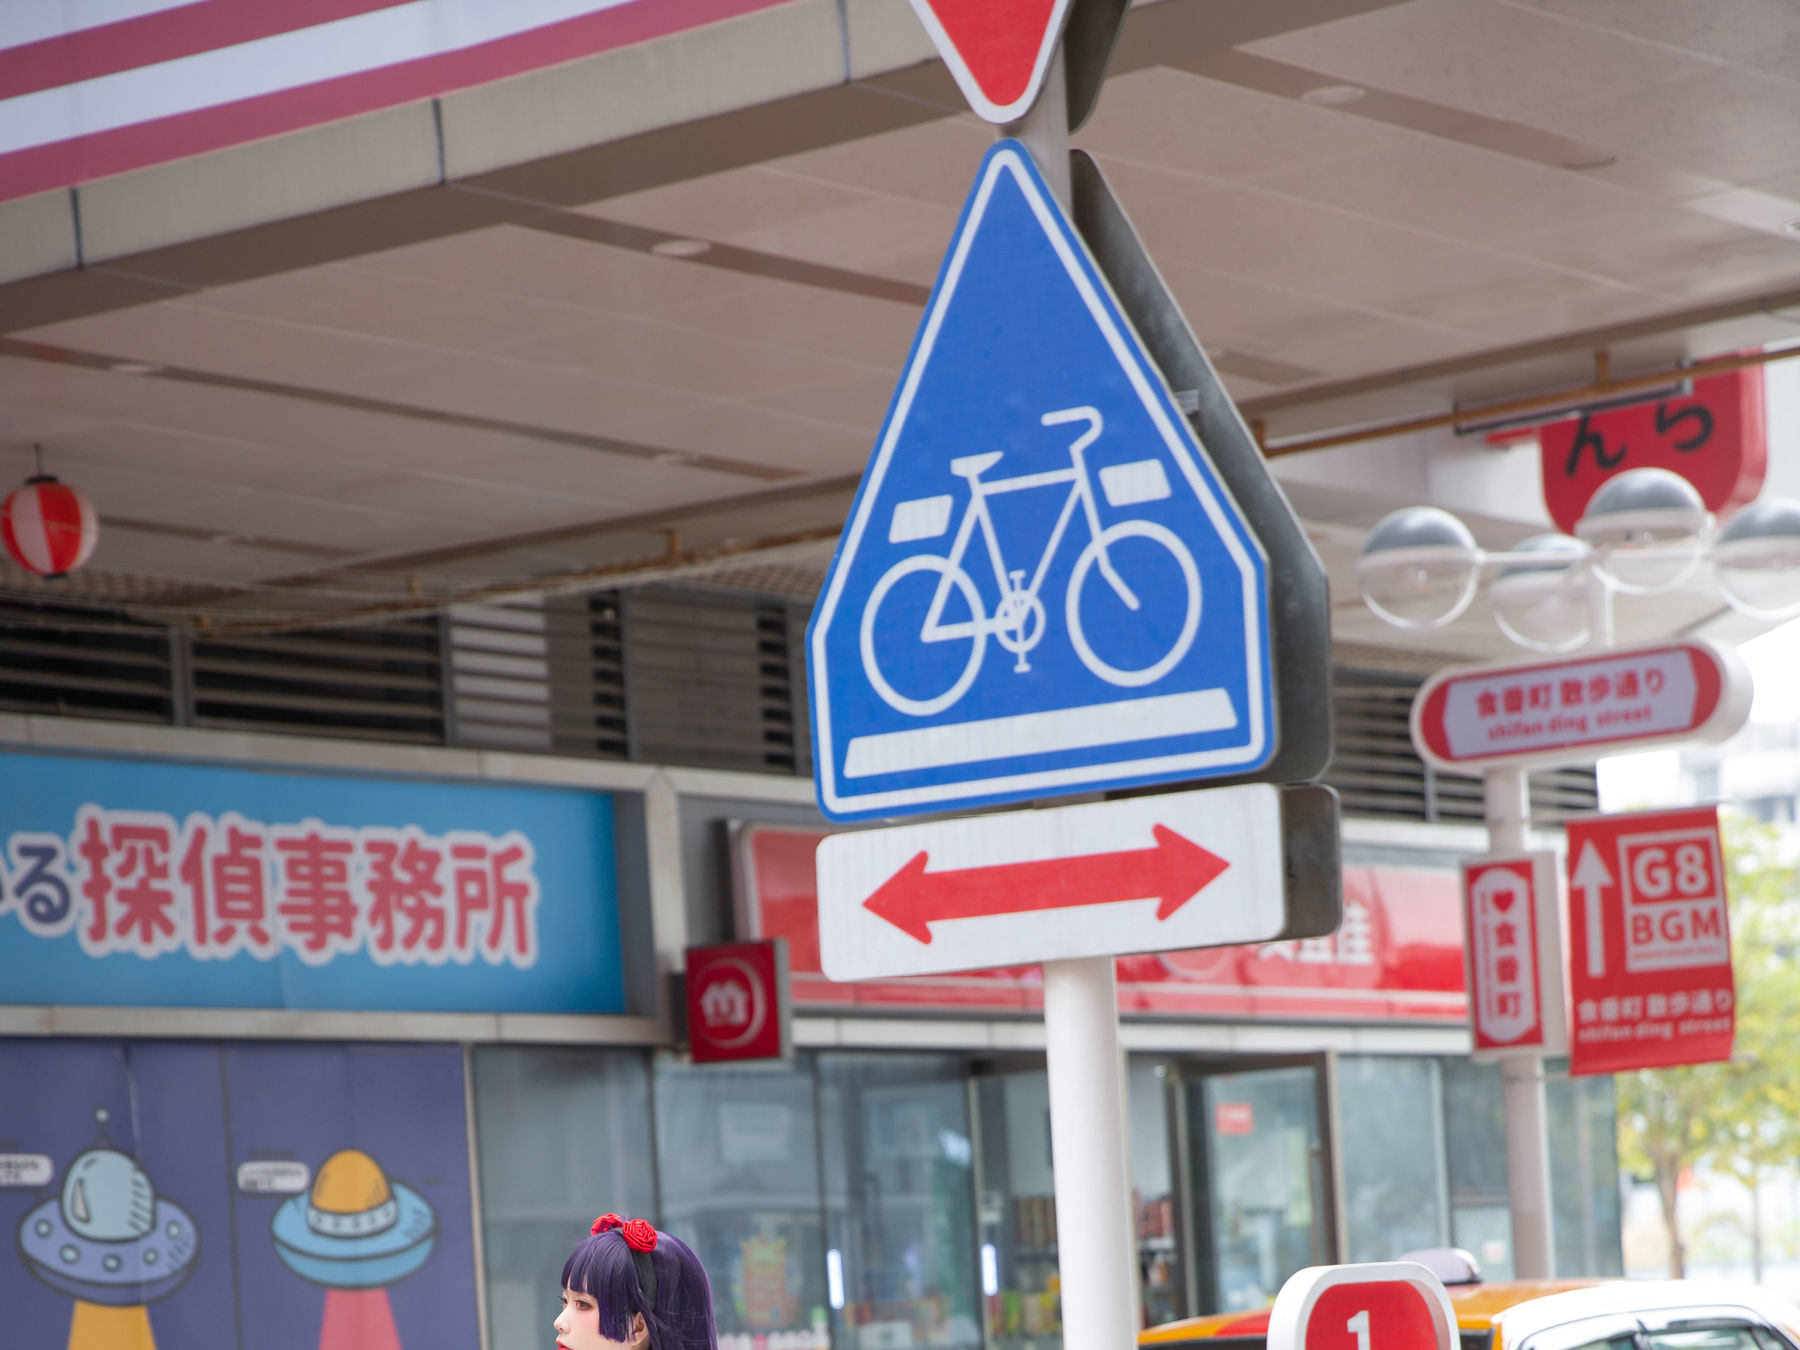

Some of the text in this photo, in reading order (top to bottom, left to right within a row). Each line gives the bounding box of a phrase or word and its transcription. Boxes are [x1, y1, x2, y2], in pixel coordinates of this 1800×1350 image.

[0, 812, 534, 960] る探偵事務所
[1633, 844, 1709, 899] G8
[1632, 906, 1720, 946] BGM
